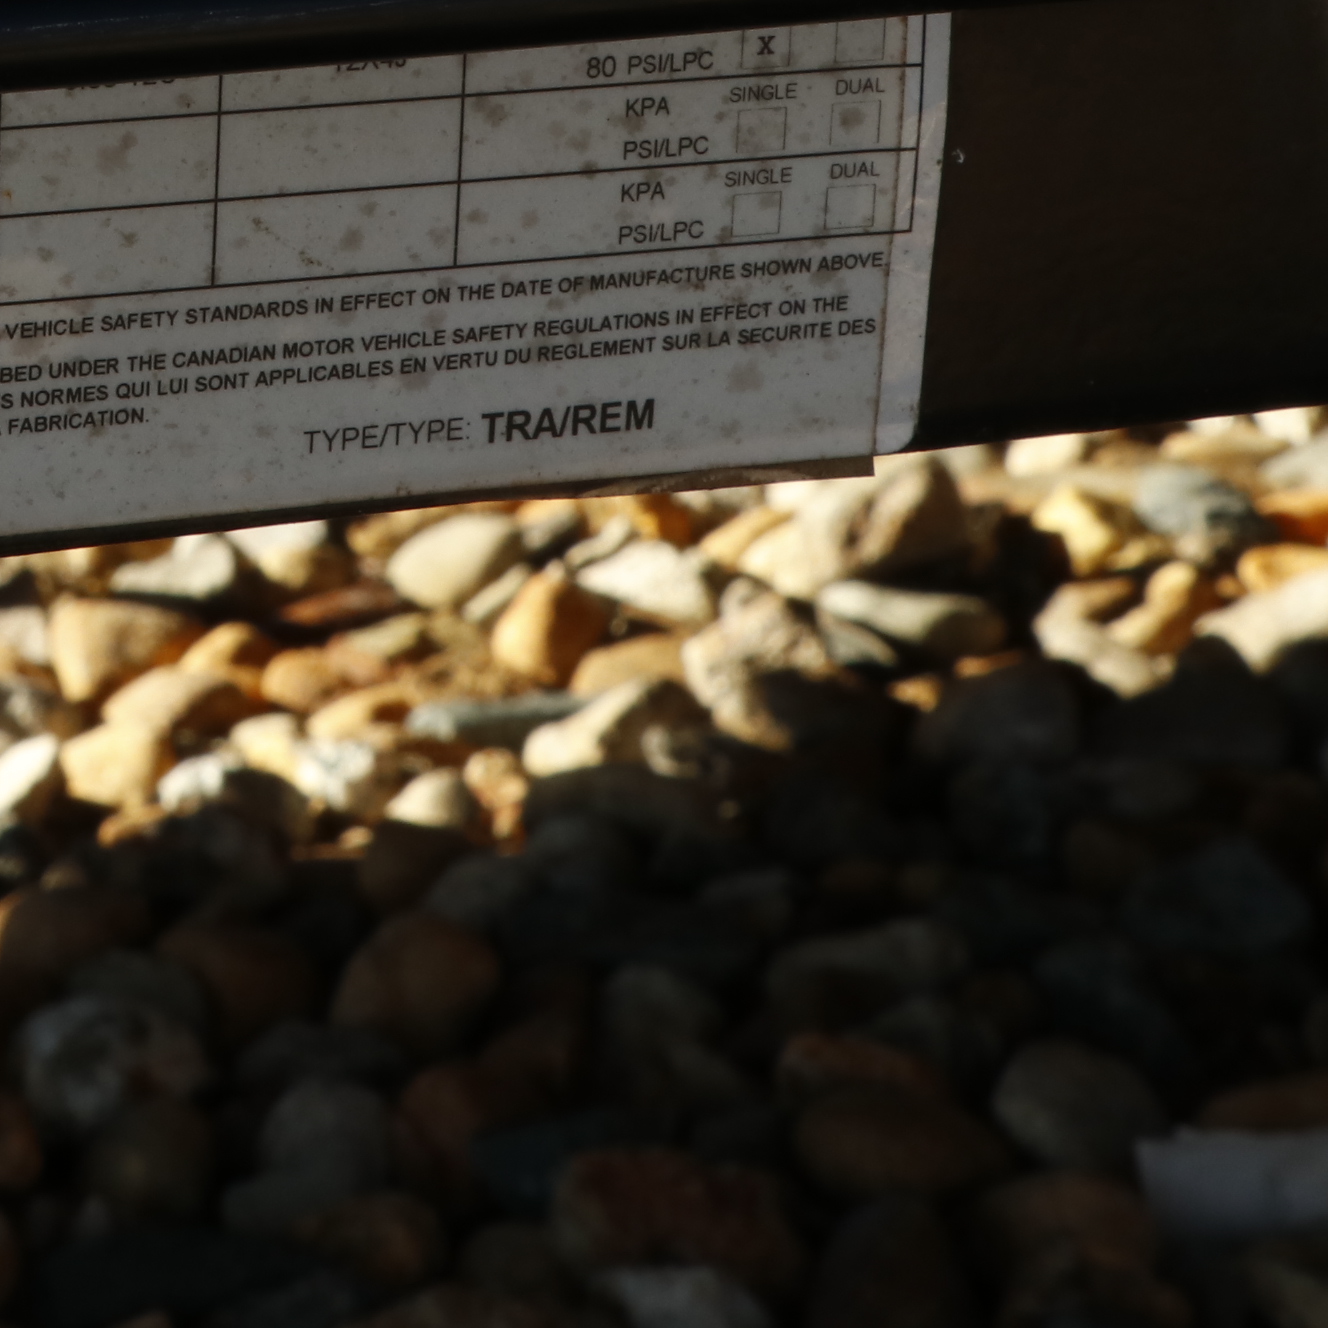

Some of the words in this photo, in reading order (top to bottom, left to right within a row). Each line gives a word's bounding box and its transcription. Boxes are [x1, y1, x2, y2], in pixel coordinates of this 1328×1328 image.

[757, 35, 776, 56] X
[586, 55, 617, 79] 80
[627, 50, 714, 75] PSI/LPC
[729, 83, 796, 103] SINGLE
[835, 78, 884, 96] DUAL
[625, 96, 670, 118] KPA
[623, 135, 709, 160] PSI/LPC
[725, 167, 792, 188] SINGLE
[830, 161, 880, 180] DUAL
[621, 181, 665, 203] KPA
[618, 220, 704, 245] PSI/LPC
[5, 316, 94, 340] VEHICLE
[100, 310, 179, 332] SAFETY
[185, 299, 309, 325] STANDARDS
[315, 297, 334, 314] IN
[340, 290, 417, 312] EFFECT
[422, 287, 451, 305] ON
[457, 283, 496, 302] THE
[501, 278, 553, 299] DATE
[557, 276, 585, 293] OF
[589, 263, 735, 292] MANUFACTURE
[740, 257, 812, 278] SHOWN
[48, 357, 119, 379] UNDER
[126, 353, 167, 372] THE
[172, 344, 276, 368] CANADIAN
[282, 337, 355, 359] MOTOR
[361, 329, 446, 352] VEHICLE
[452, 322, 528, 344] SAFETY
[533, 310, 670, 337] REGULATIONS
[676, 308, 694, 325] IN
[700, 301, 773, 323] EFFECT
[778, 299, 806, 316] ON
[812, 295, 849, 313] THE
[20, 384, 109, 408] NORMES
[115, 381, 150, 399] QUI
[157, 377, 188, 396] LUI
[194, 372, 250, 393] SONT
[255, 360, 394, 388] APPLICABLES
[400, 357, 426, 375] EN
[432, 350, 498, 371] VERTU
[504, 347, 532, 366] DU
[537, 336, 656, 362] REGLEMENT
[662, 333, 701, 352] SUR
[706, 331, 731, 348] LA
[737, 321, 832, 345] SECURITE
[838, 318, 876, 336] DES
[8, 407, 150, 435] FABRICATION.
[303, 417, 472, 454] TYPE/TYPE:
[481, 398, 655, 444] TRA/REM
